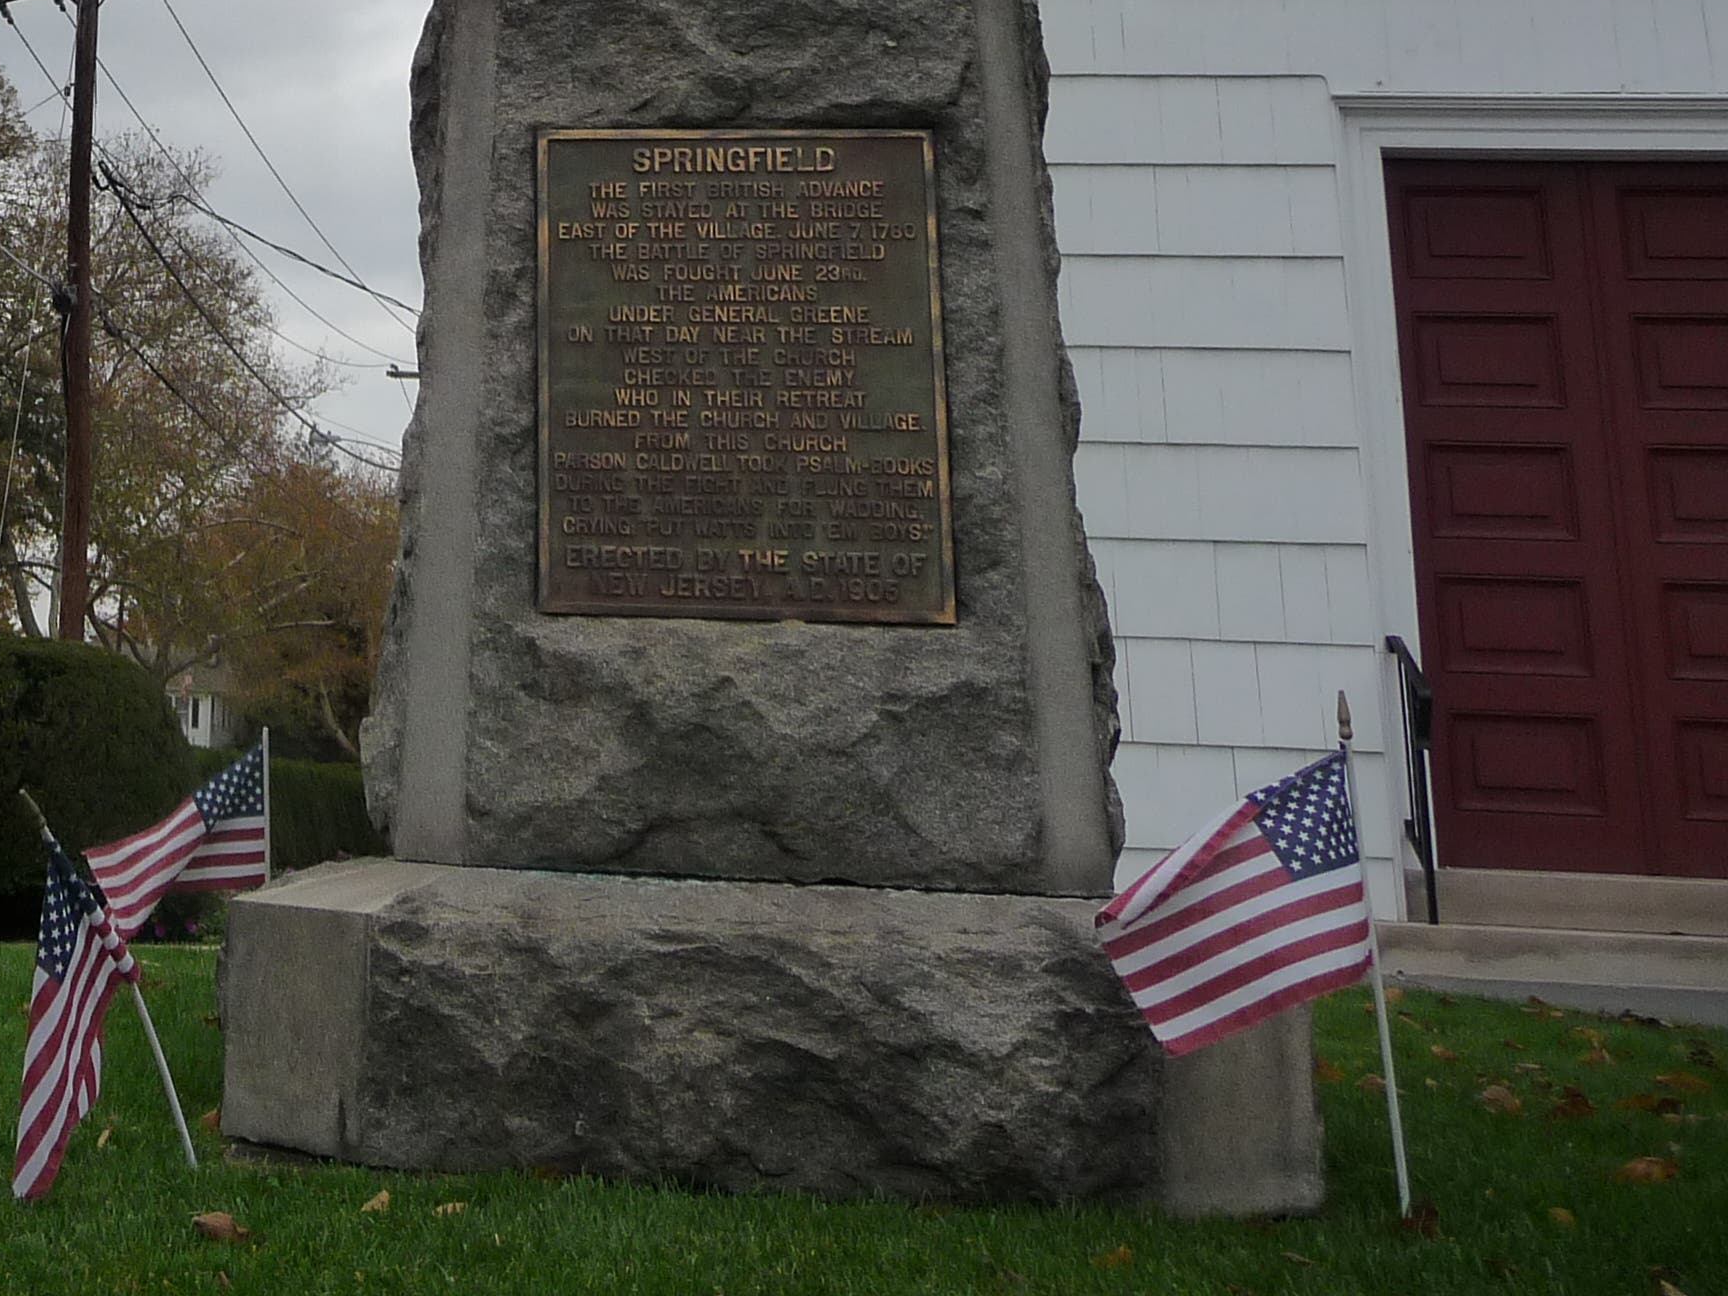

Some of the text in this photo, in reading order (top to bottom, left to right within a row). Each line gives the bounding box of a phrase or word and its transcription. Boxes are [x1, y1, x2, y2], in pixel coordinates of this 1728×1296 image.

[632, 146, 836, 172] SPRINGFIELD
[589, 180, 885, 199] THE FIRST BRITISH ADVANCE
[591, 201, 884, 219] WAS STAYED AT THE BRIDGE
[558, 222, 606, 239] EAST
[615, 222, 640, 239] OF
[646, 222, 686, 239] THE
[788, 222, 841, 239] JUNE
[870, 222, 917, 240] 1780
[589, 243, 886, 260] THE BATTLE OF SPRINGFIELD
[611, 264, 650, 281] WAS
[663, 264, 742, 281] FOUGHT
[751, 264, 803, 281] JUNE
[657, 284, 818, 302] THE AMERICANS
[610, 306, 870, 323] UNDER GENERAL GREENE
[567, 326, 914, 345] ON THAT DAY NEAR THE STREAM
[622, 347, 856, 366] WEST OF THE CHURCH
[624, 368, 717, 386] CHECKED
[731, 369, 772, 386] THE
[615, 389, 867, 408] WHO IN THEIR RETREAT
[565, 410, 641, 427] BURNED
[650, 411, 689, 427] THE
[700, 411, 780, 429] CHURCH
[790, 412, 828, 430] AND
[634, 432, 847, 451] FROM THIS CHURCH
[554, 452, 626, 470] PARSON
[636, 453, 732, 471] CALDWELL
[737, 454, 788, 472] TOOK
[555, 473, 934, 498] DURING THE FIGHT AND FLUNG THEM
[568, 495, 593, 512] TO
[600, 496, 643, 513] THE
[655, 496, 763, 516] AMERICANS
[778, 499, 816, 517] FOR
[695, 519, 756, 537] WATTS
[565, 544, 928, 576] ERECTED BY THE STATE OF
[593, 571, 647, 595] NEW
